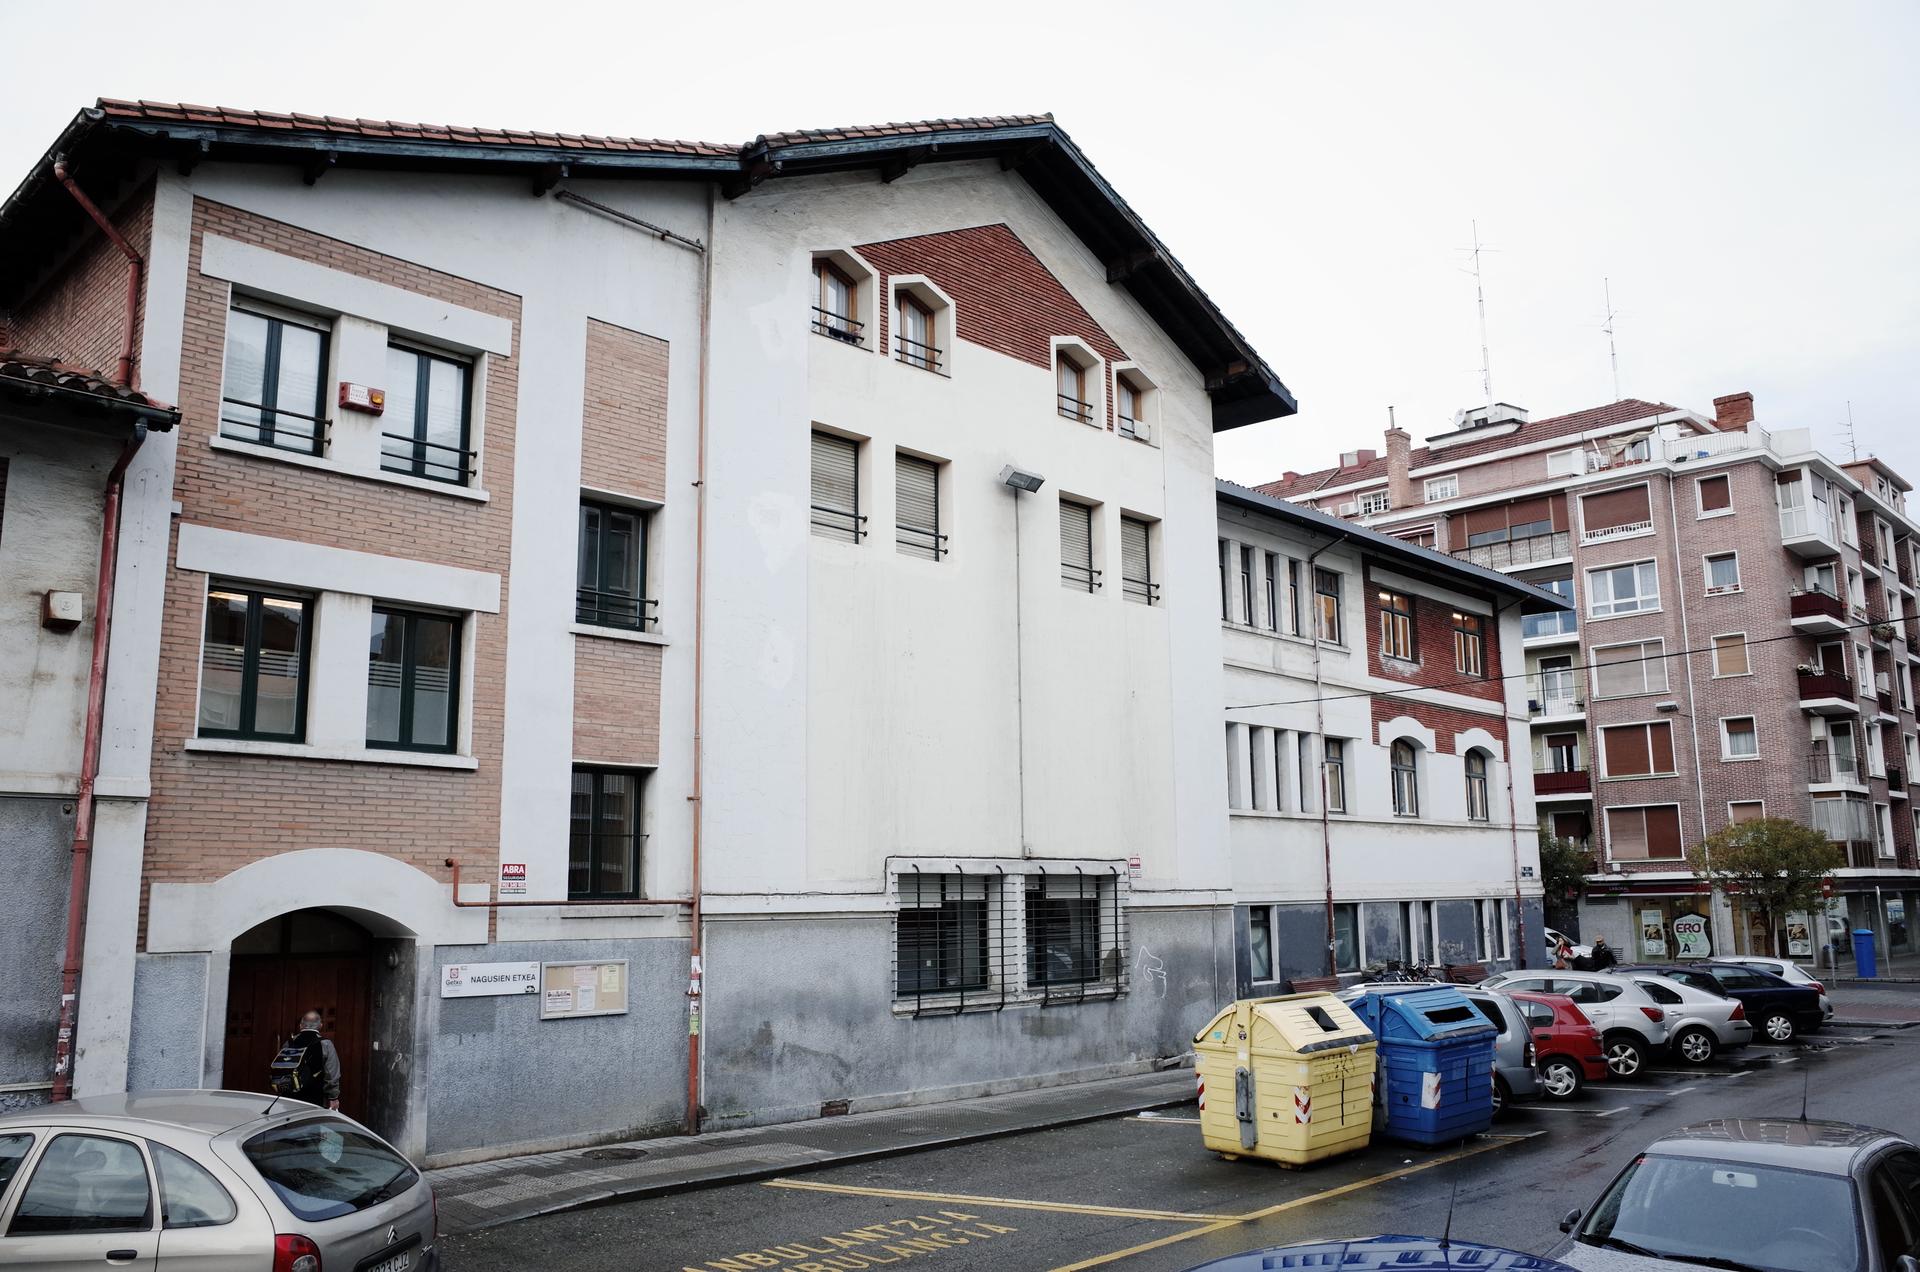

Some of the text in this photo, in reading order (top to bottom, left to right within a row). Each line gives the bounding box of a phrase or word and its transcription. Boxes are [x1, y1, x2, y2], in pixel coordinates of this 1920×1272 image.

[503, 865, 524, 874] ABRA
[1676, 923, 1701, 933] ERO
[470, 973, 536, 983] NAGUSIEN ETXEA
[682, 1211, 981, 1272] NBULANTZIA
[782, 1222, 1018, 1272] BULANCIA
